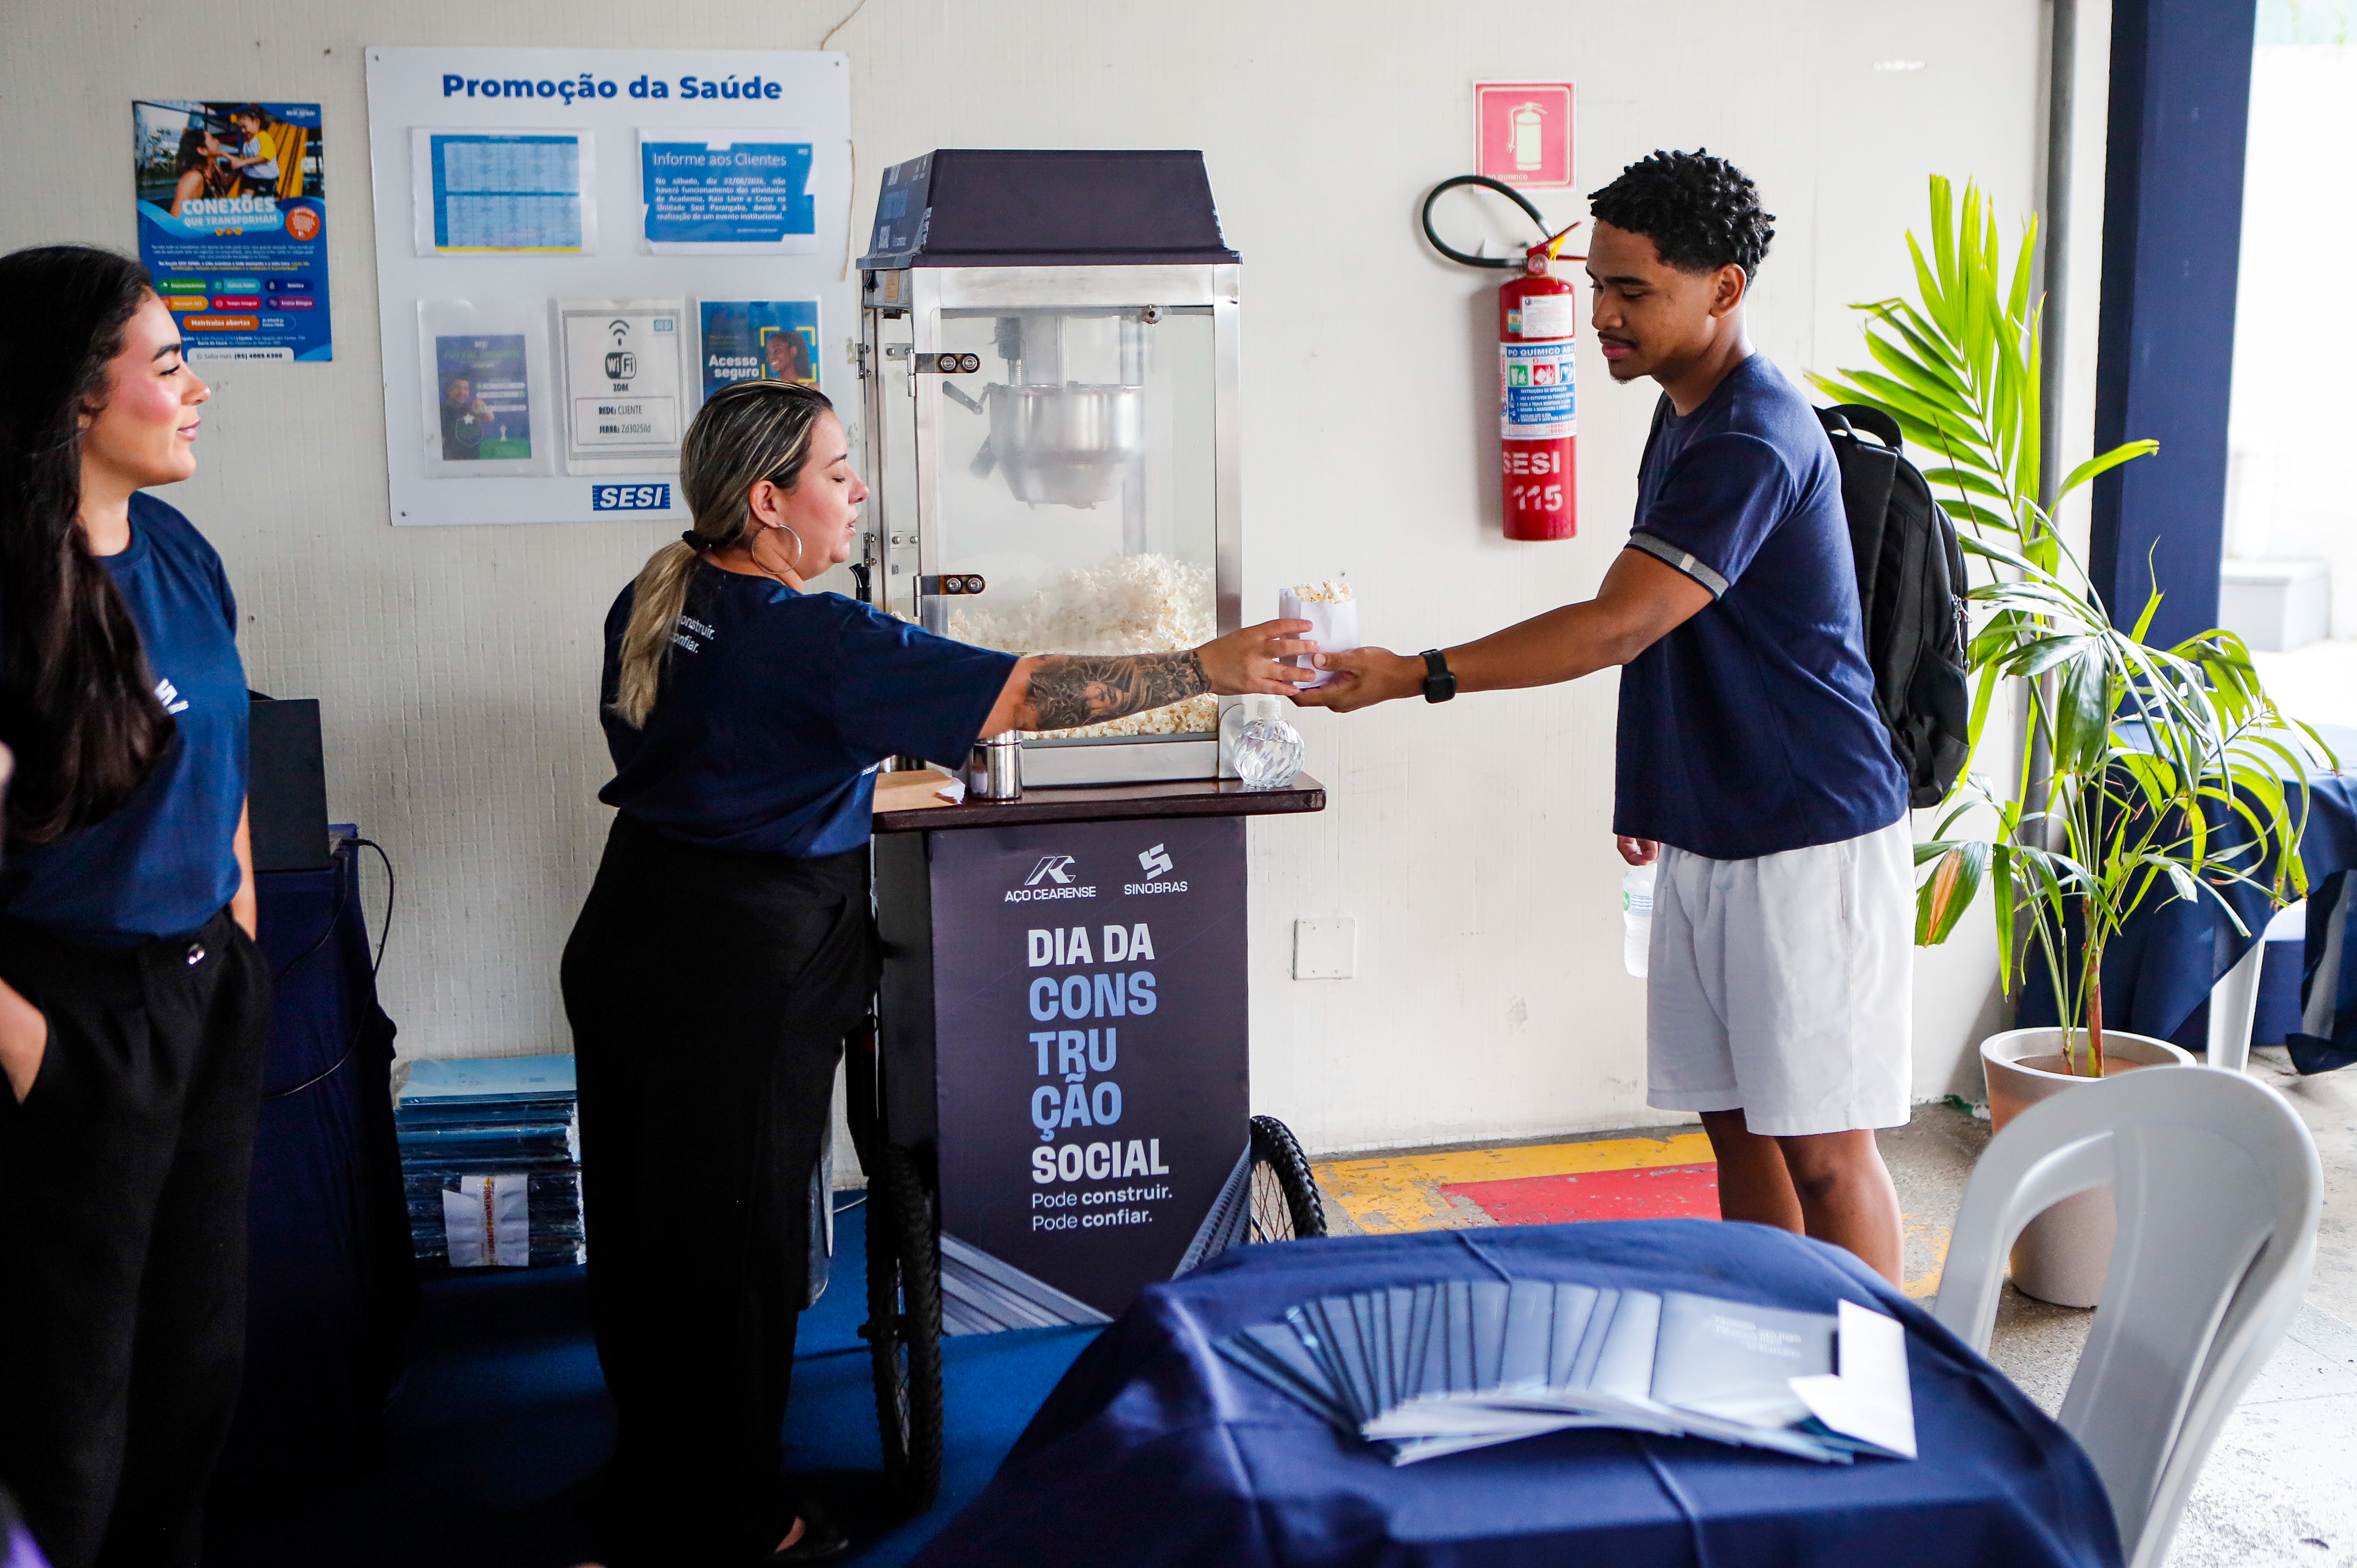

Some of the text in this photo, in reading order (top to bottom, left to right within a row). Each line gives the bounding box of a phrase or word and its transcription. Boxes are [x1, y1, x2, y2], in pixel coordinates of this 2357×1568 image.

[443, 73, 782, 106] Promoção da Saúde
[653, 152, 787, 166] Informe aos Clientes
[181, 194, 276, 215] CONEXÕES
[184, 215, 277, 227] QUE TRANSFORMAM
[709, 354, 758, 367] Acesso
[1520, 347, 1560, 356] QUÍMICO
[1563, 345, 1574, 353] ABC
[714, 368, 760, 380] seguro
[599, 405, 642, 415] REDE: CLIENTE
[1503, 451, 1560, 475] SESI
[600, 487, 663, 508] SESI
[1513, 485, 1563, 511] 115
[1005, 886, 1096, 902] AÇO CEARENSE
[1124, 881, 1188, 895] SINOBRAS
[1028, 923, 1155, 967] DIA DA
[1029, 970, 1157, 1022] CONS
[1029, 1027, 1117, 1076] TRU
[1031, 1072, 1122, 1142] ÇÃO
[1032, 1138, 1170, 1184] SOCIAL
[1032, 1183, 1173, 1209] Pode construir.
[1032, 1209, 1153, 1232] Pode confiar.
